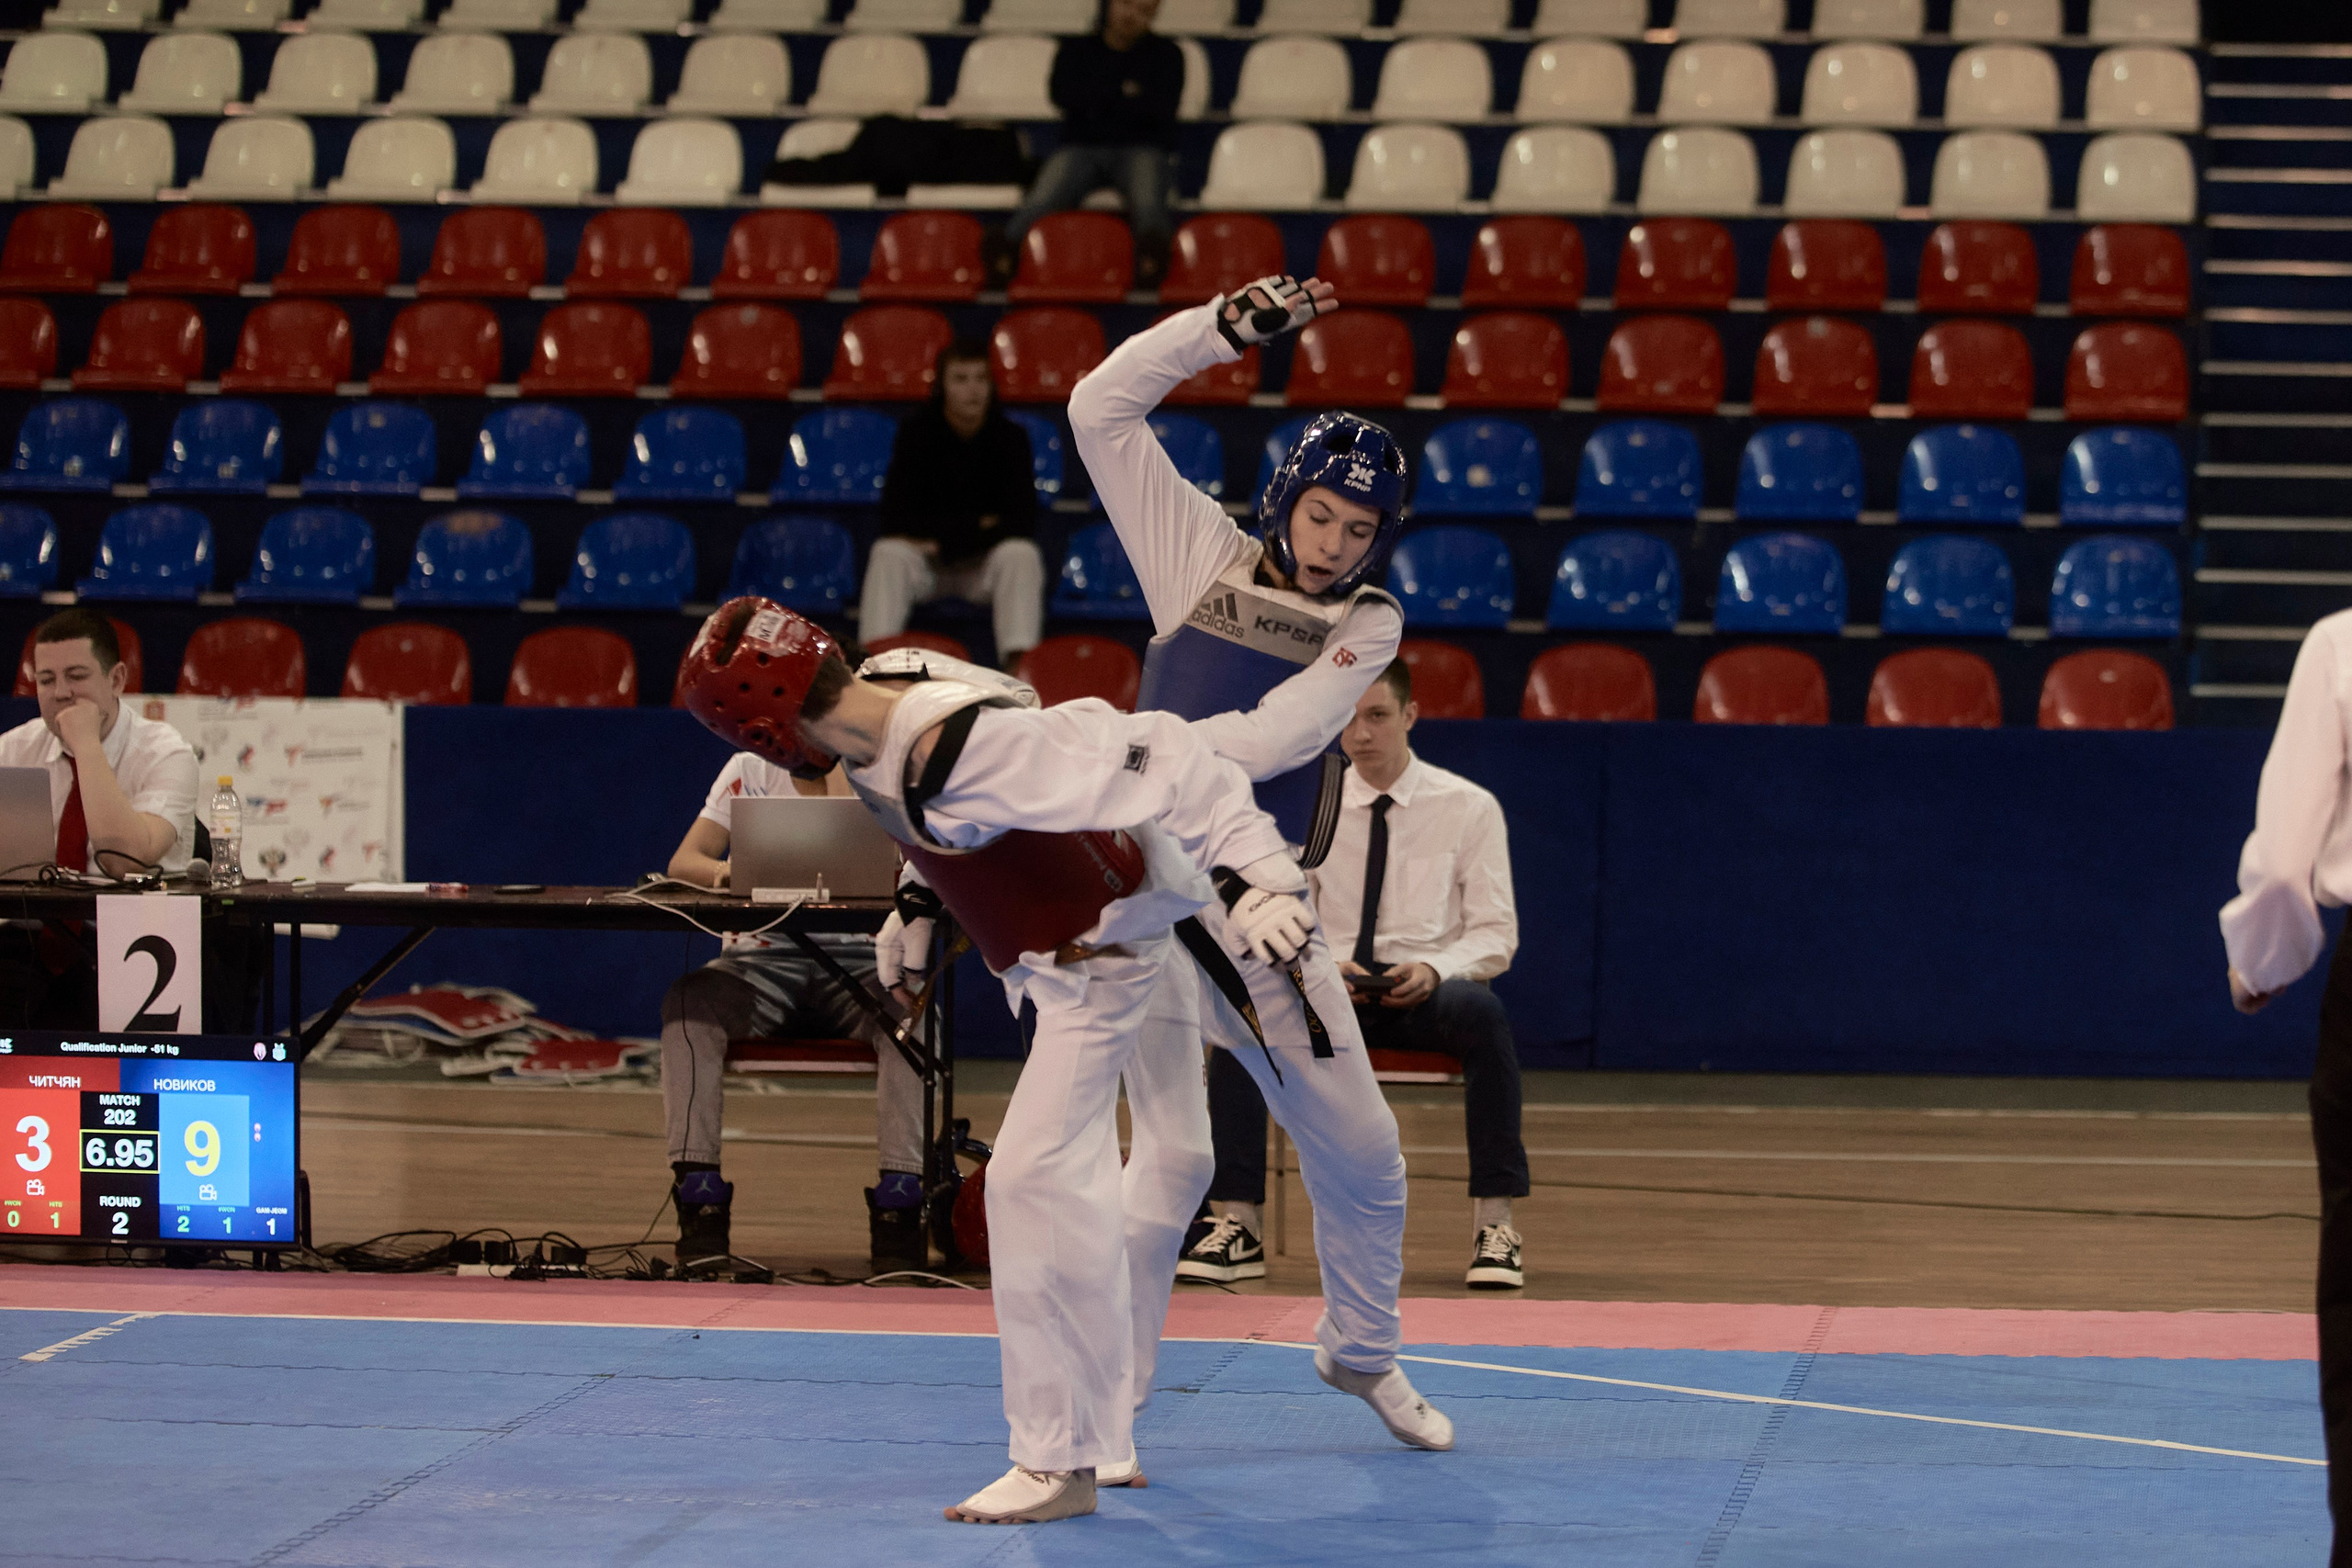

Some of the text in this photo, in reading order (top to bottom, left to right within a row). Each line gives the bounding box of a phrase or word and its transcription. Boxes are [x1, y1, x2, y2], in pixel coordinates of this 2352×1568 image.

[1343, 478, 1371, 491] KPNP
[1192, 609, 1245, 638] adidas
[123, 934, 182, 1032] 2
[60, 1042, 117, 1053] Qualification
[118, 1043, 147, 1054] Junior
[166, 1044, 180, 1055] kg
[28, 1075, 82, 1089] ЧИТЧЯН
[153, 1078, 216, 1092] НОВИКОВ
[99, 1094, 141, 1107] MATCH
[104, 1108, 137, 1126] 202
[15, 1115, 52, 1172] 3
[85, 1137, 154, 1168] 6.95
[184, 1120, 220, 1177] 9
[99, 1195, 141, 1208] ROUND
[7, 1210, 20, 1228] 0
[50, 1212, 60, 1229] 1
[111, 1211, 130, 1235] 2
[176, 1215, 190, 1233] 2
[222, 1217, 232, 1235] 1
[266, 1217, 276, 1235] 1
